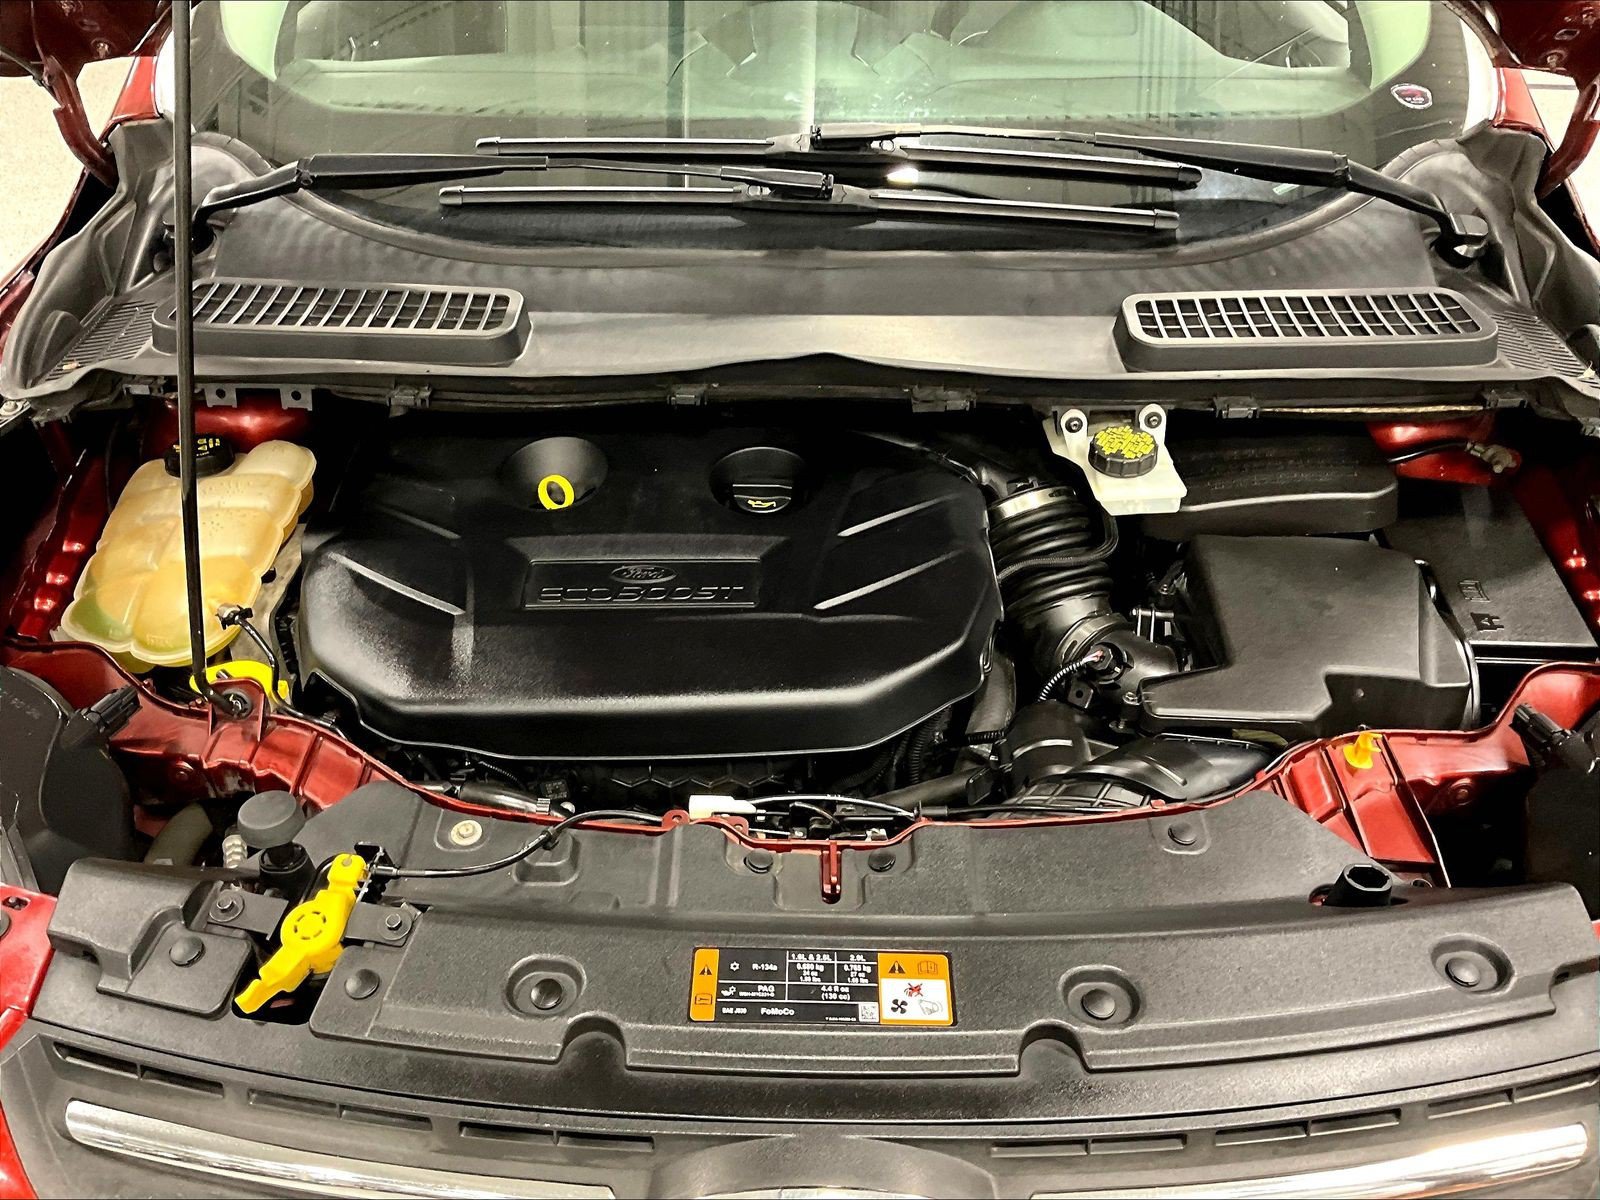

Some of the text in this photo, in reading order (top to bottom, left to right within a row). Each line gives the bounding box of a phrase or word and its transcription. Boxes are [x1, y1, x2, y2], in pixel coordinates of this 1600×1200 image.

[622, 566, 665, 579] Ford
[538, 586, 744, 602] ECOBOOST
[752, 963, 778, 971] R-134a
[815, 963, 824, 972] kg
[863, 964, 872, 973] kg
[821, 985, 833, 993] 4.4
[821, 993, 837, 1001] (130
[760, 1008, 795, 1016] FoMoCo
